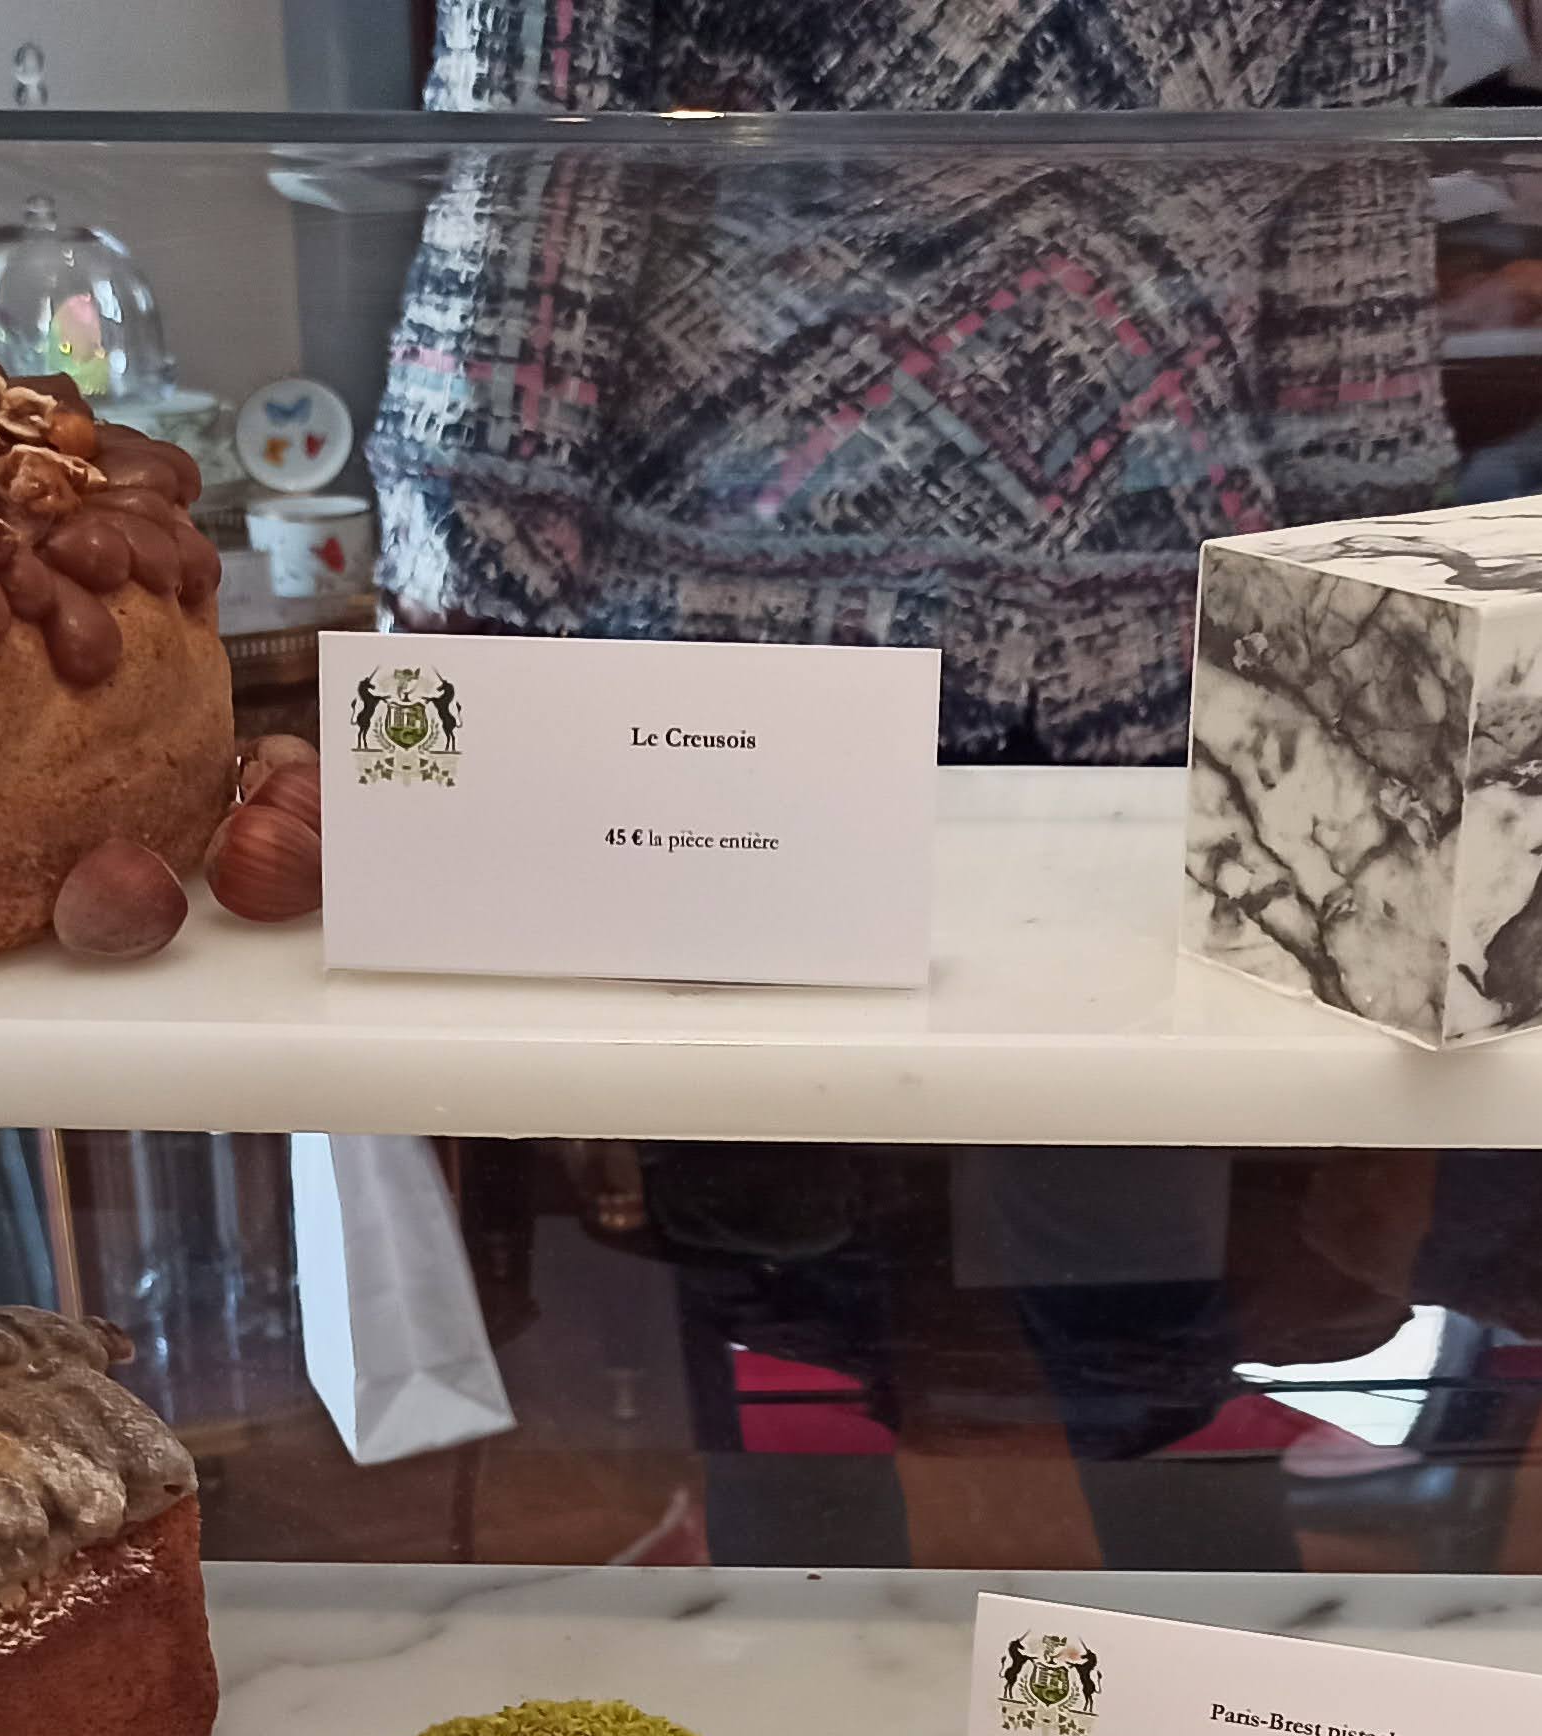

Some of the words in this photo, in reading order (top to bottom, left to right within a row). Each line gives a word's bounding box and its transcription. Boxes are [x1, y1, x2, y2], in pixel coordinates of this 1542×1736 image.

[631, 727, 658, 747] Le
[665, 727, 757, 749] Creusois
[604, 829, 626, 846] 45
[631, 829, 643, 846] €
[648, 829, 662, 847] la
[668, 829, 714, 853] pièce
[719, 830, 780, 850] entière
[1210, 1703, 1321, 1736] Paris-Brest
